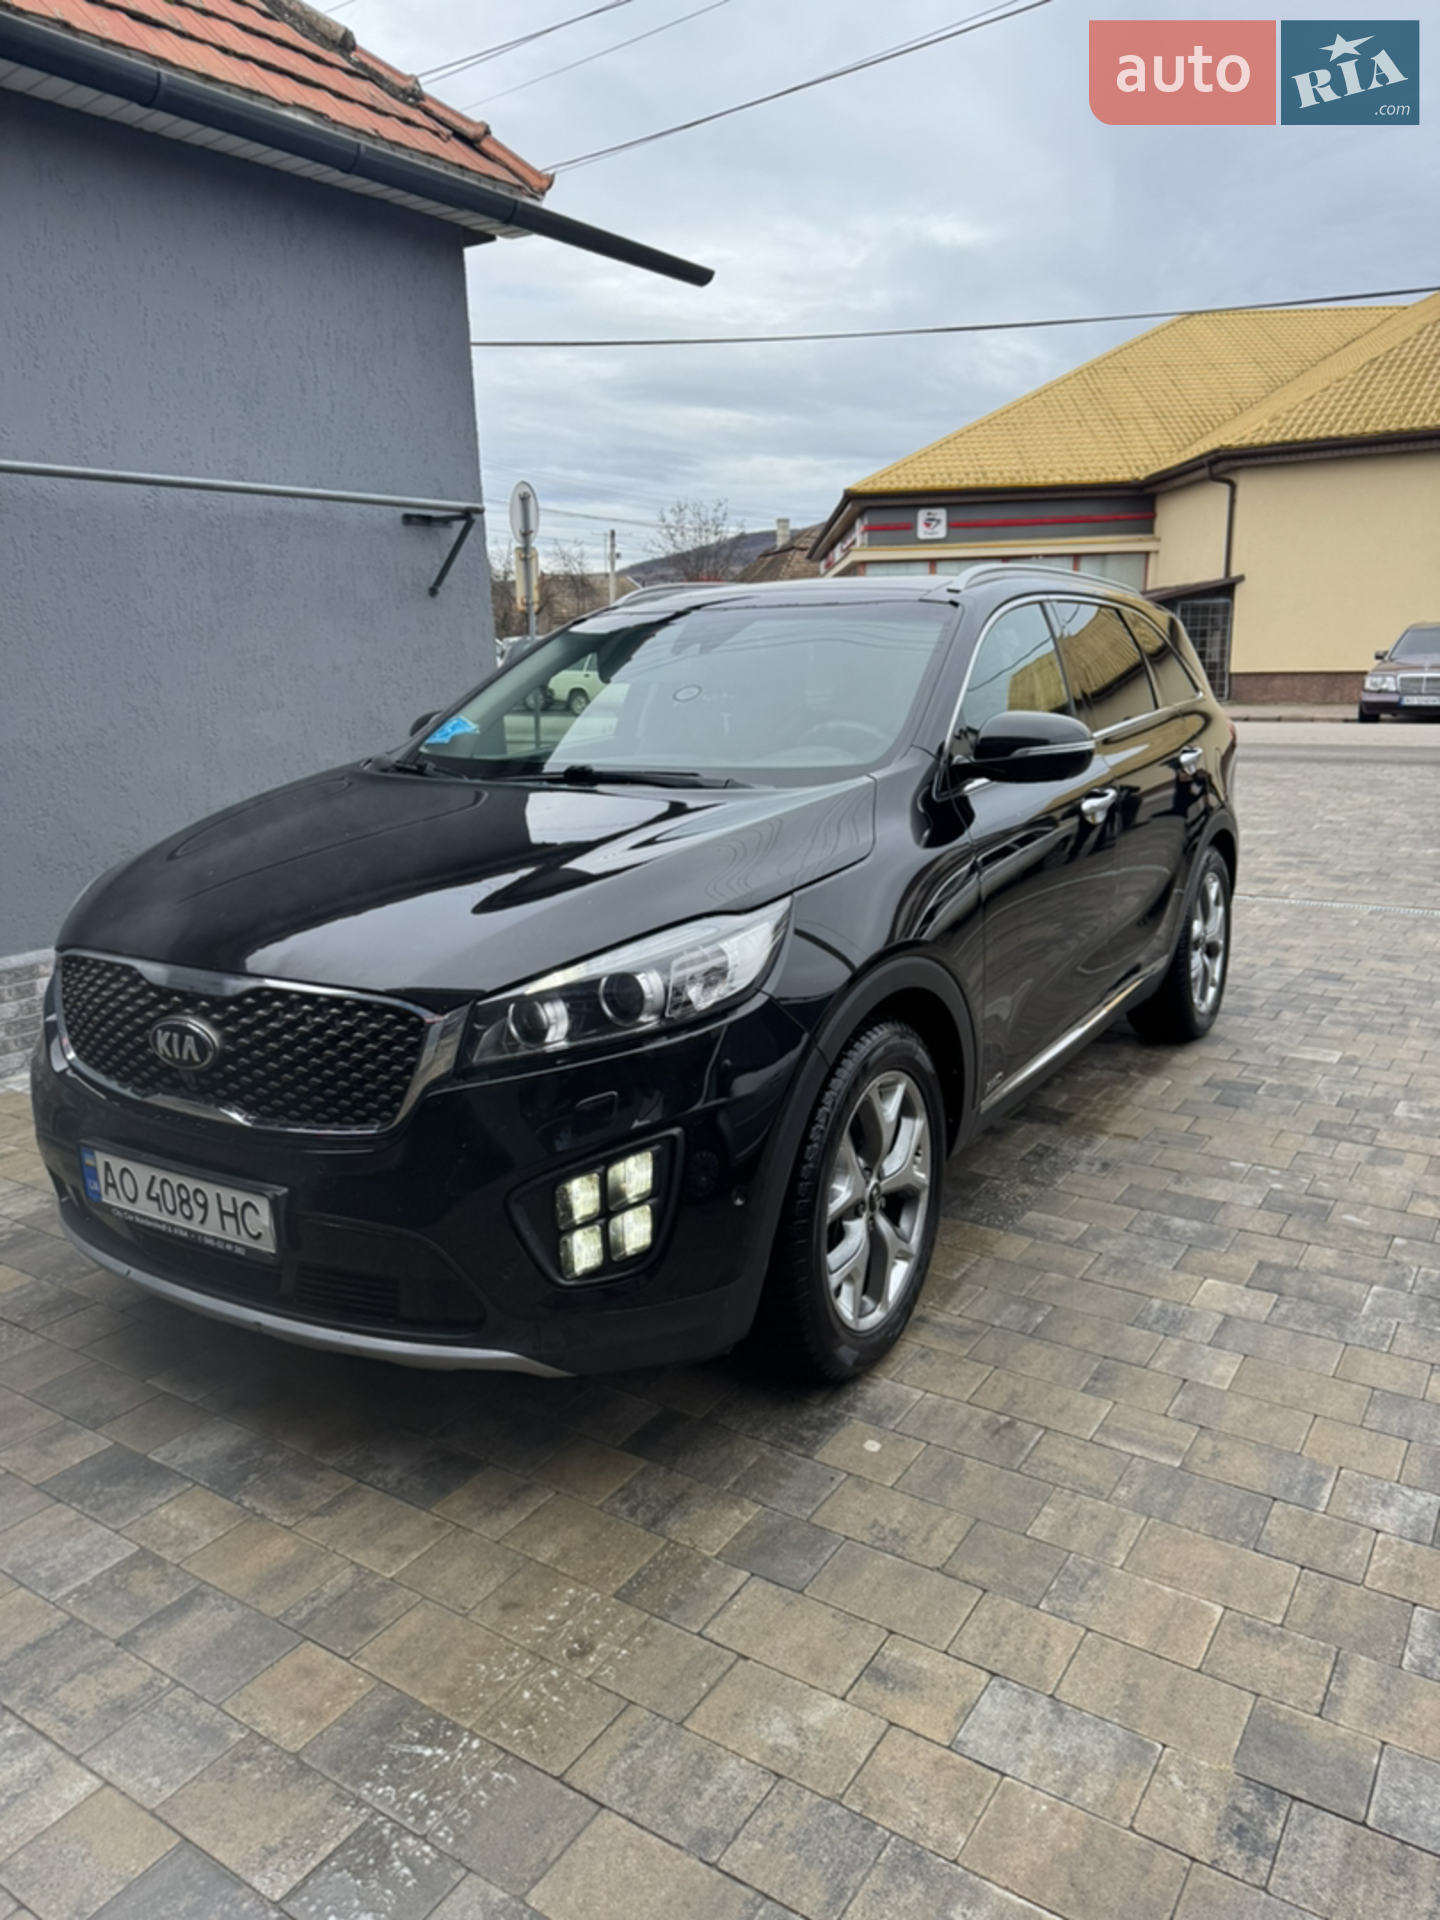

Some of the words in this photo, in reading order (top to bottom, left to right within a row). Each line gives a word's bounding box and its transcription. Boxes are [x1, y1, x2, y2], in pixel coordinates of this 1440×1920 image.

[156, 1029, 201, 1062] KIA
[104, 1161, 139, 1204] AO
[146, 1175, 209, 1225] 4089
[215, 1192, 263, 1240] HC
